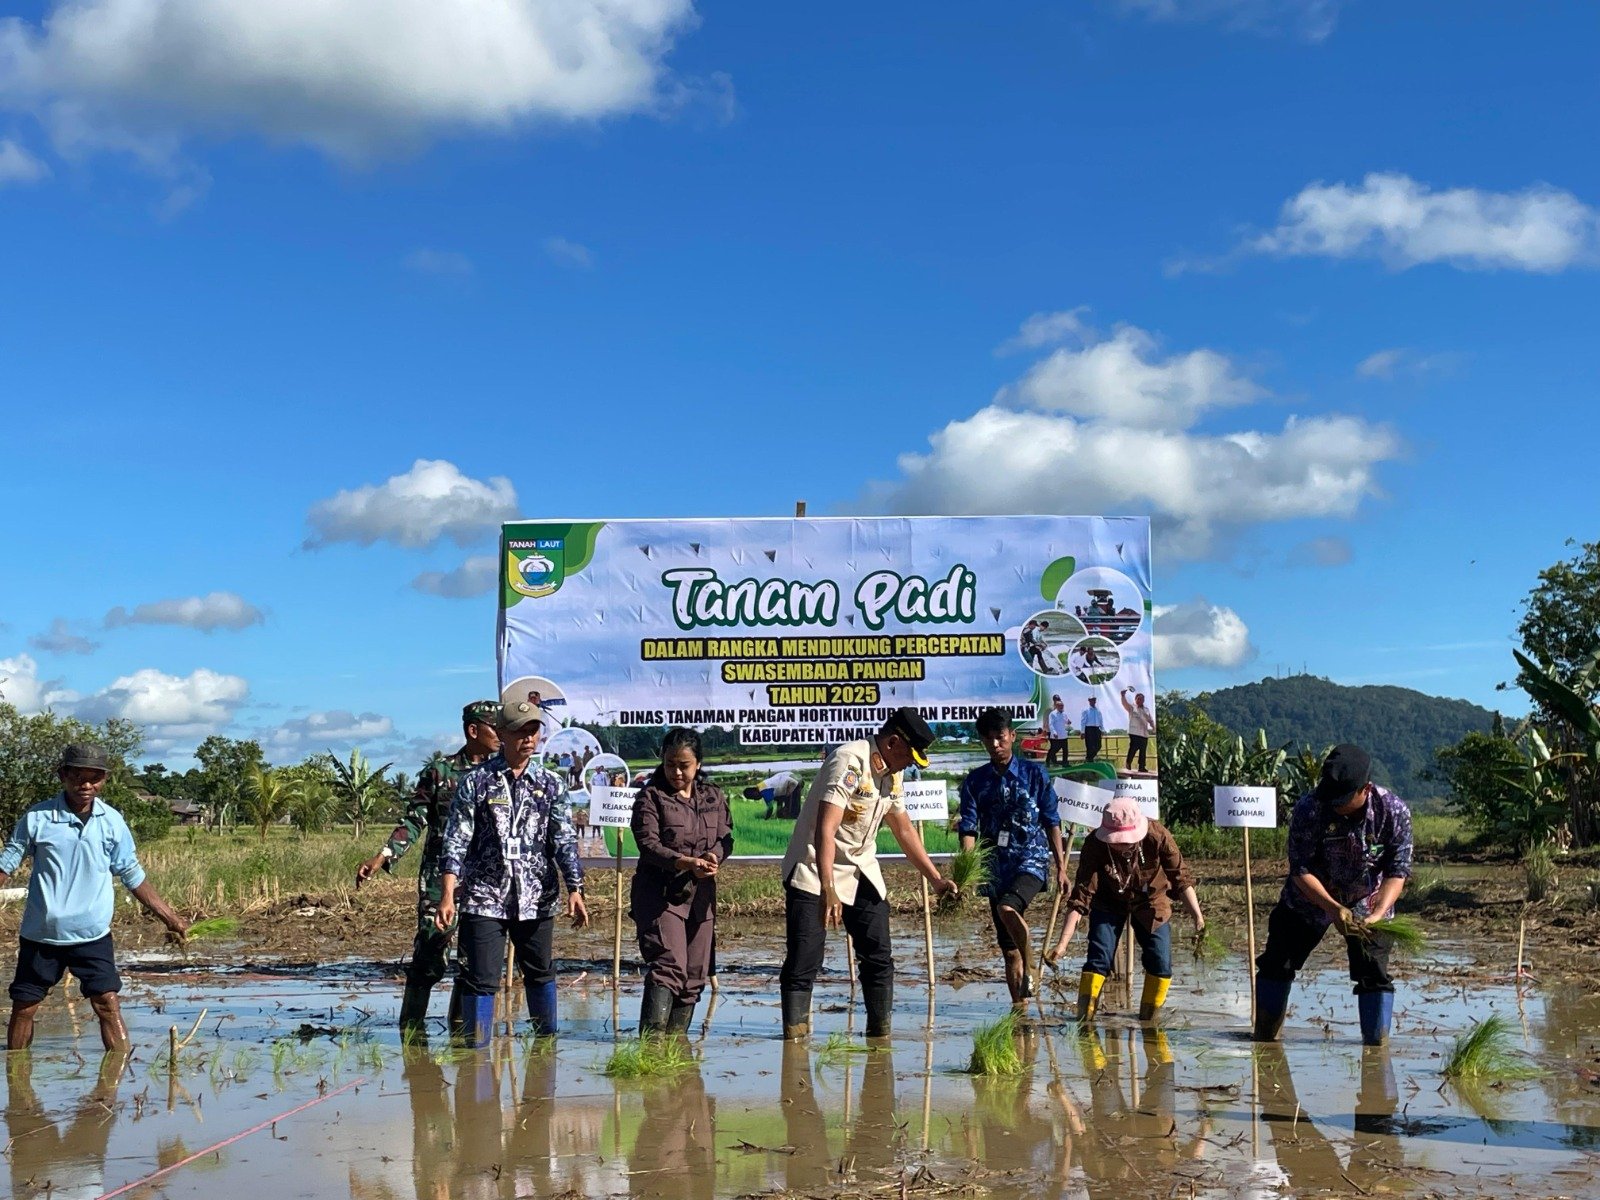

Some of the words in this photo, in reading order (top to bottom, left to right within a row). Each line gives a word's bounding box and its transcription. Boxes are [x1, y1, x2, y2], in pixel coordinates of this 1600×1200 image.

[508, 540, 536, 548] TANAH
[539, 540, 560, 548] LAUT
[664, 569, 838, 628] Tanam
[858, 564, 975, 629] Padi
[644, 640, 703, 658] DALAM
[707, 639, 778, 657] RANGKA
[782, 638, 891, 656] MENDUKUNG
[895, 636, 1002, 655] PERCEPATAN
[724, 662, 849, 681] SWASEMBADA
[852, 661, 921, 679] PANGAN
[769, 686, 827, 704] TAHUN
[830, 686, 877, 703] 2025
[620, 710, 664, 725] DINAS
[667, 710, 735, 724] TANAMAN
[738, 709, 795, 723] PANGAN
[799, 708, 897, 722] HORTIKULTUR
[915, 707, 938, 720] AN
[942, 705, 1035, 720] PERKENAN
[742, 728, 824, 743] KABUPATEN
[829, 727, 874, 742] TANAH
[610, 791, 637, 799] KEPALA
[905, 803, 919, 811] ROV
[920, 802, 944, 810] KALSEL
[1227, 809, 1265, 817] PELAIHARI
[599, 815, 625, 824] NEGERI
